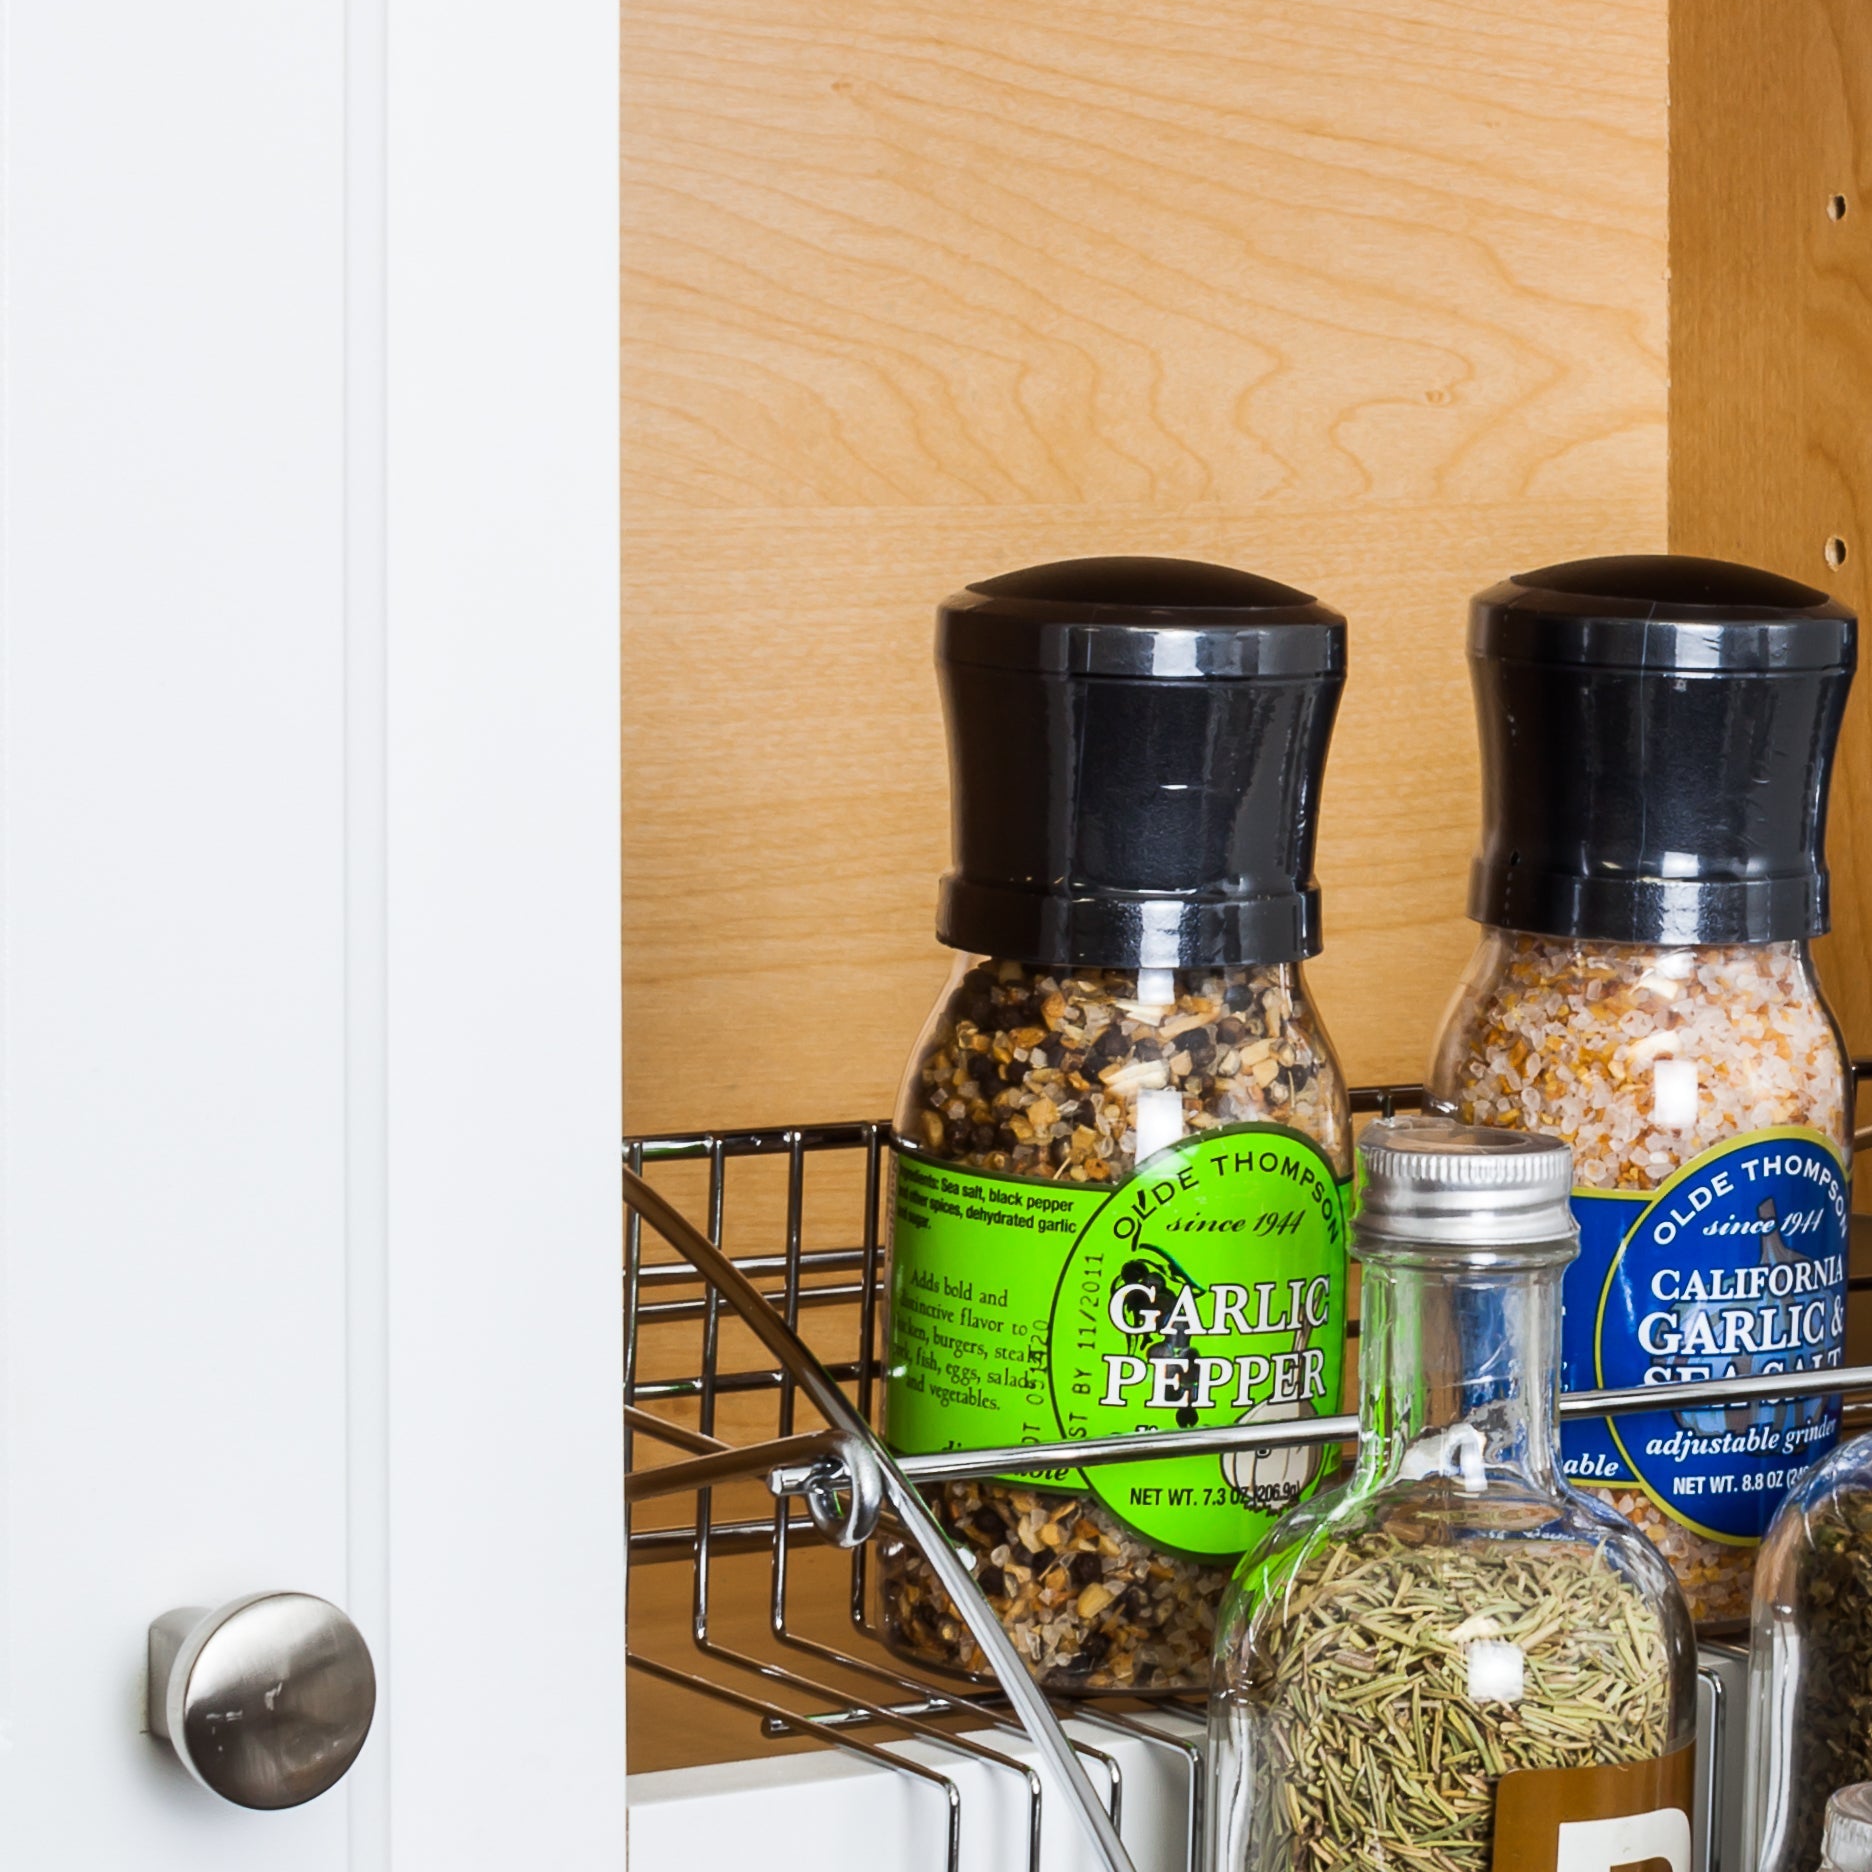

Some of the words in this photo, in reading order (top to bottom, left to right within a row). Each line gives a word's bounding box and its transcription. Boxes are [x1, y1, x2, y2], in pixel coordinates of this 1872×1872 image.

[940, 1177, 960, 1196] Sea
[961, 1183, 986, 1203] salt,
[988, 1187, 1023, 1207] black
[1026, 1196, 1075, 1213] pepper
[1112, 1167, 1200, 1241] OLDE
[1209, 1150, 1340, 1246] THOMPSON
[1652, 1170, 1736, 1247] OLDE
[1740, 1153, 1849, 1240] THOMPSON
[965, 1204, 1035, 1229] dehydrated
[1037, 1214, 1078, 1234] garlic
[1165, 1209, 1247, 1234] since
[1256, 1208, 1308, 1238] 1944
[1701, 1212, 1777, 1237] since
[1780, 1207, 1825, 1237] 1944
[943, 1275, 973, 1301] bold
[978, 1288, 1009, 1308] and
[1650, 1252, 1844, 1302] CALIFORNIA
[1076, 1252, 1105, 1350] 11/2011
[1108, 1275, 1331, 1336] GARLIC
[959, 1306, 1005, 1333] flavor
[1011, 1322, 1029, 1337] to
[1636, 1300, 1826, 1357] GARLIC
[1831, 1294, 1845, 1338] &
[932, 1325, 988, 1361] burgers,
[945, 1361, 982, 1387] eggs,
[1071, 1367, 1093, 1395] BY
[1099, 1347, 1328, 1409] PEPPER
[928, 1381, 1001, 1412] vegetables.
[1645, 1423, 1780, 1463] adjustable
[1781, 1414, 1838, 1455] grinder
[1129, 1487, 1163, 1507] NET
[1168, 1487, 1198, 1507] WT.
[1203, 1487, 1226, 1506] 7.3
[1672, 1476, 1706, 1496] NET
[1707, 1475, 1739, 1494] WT.
[1741, 1472, 1765, 1492] 8.8
[1766, 1470, 1784, 1489] OZ
